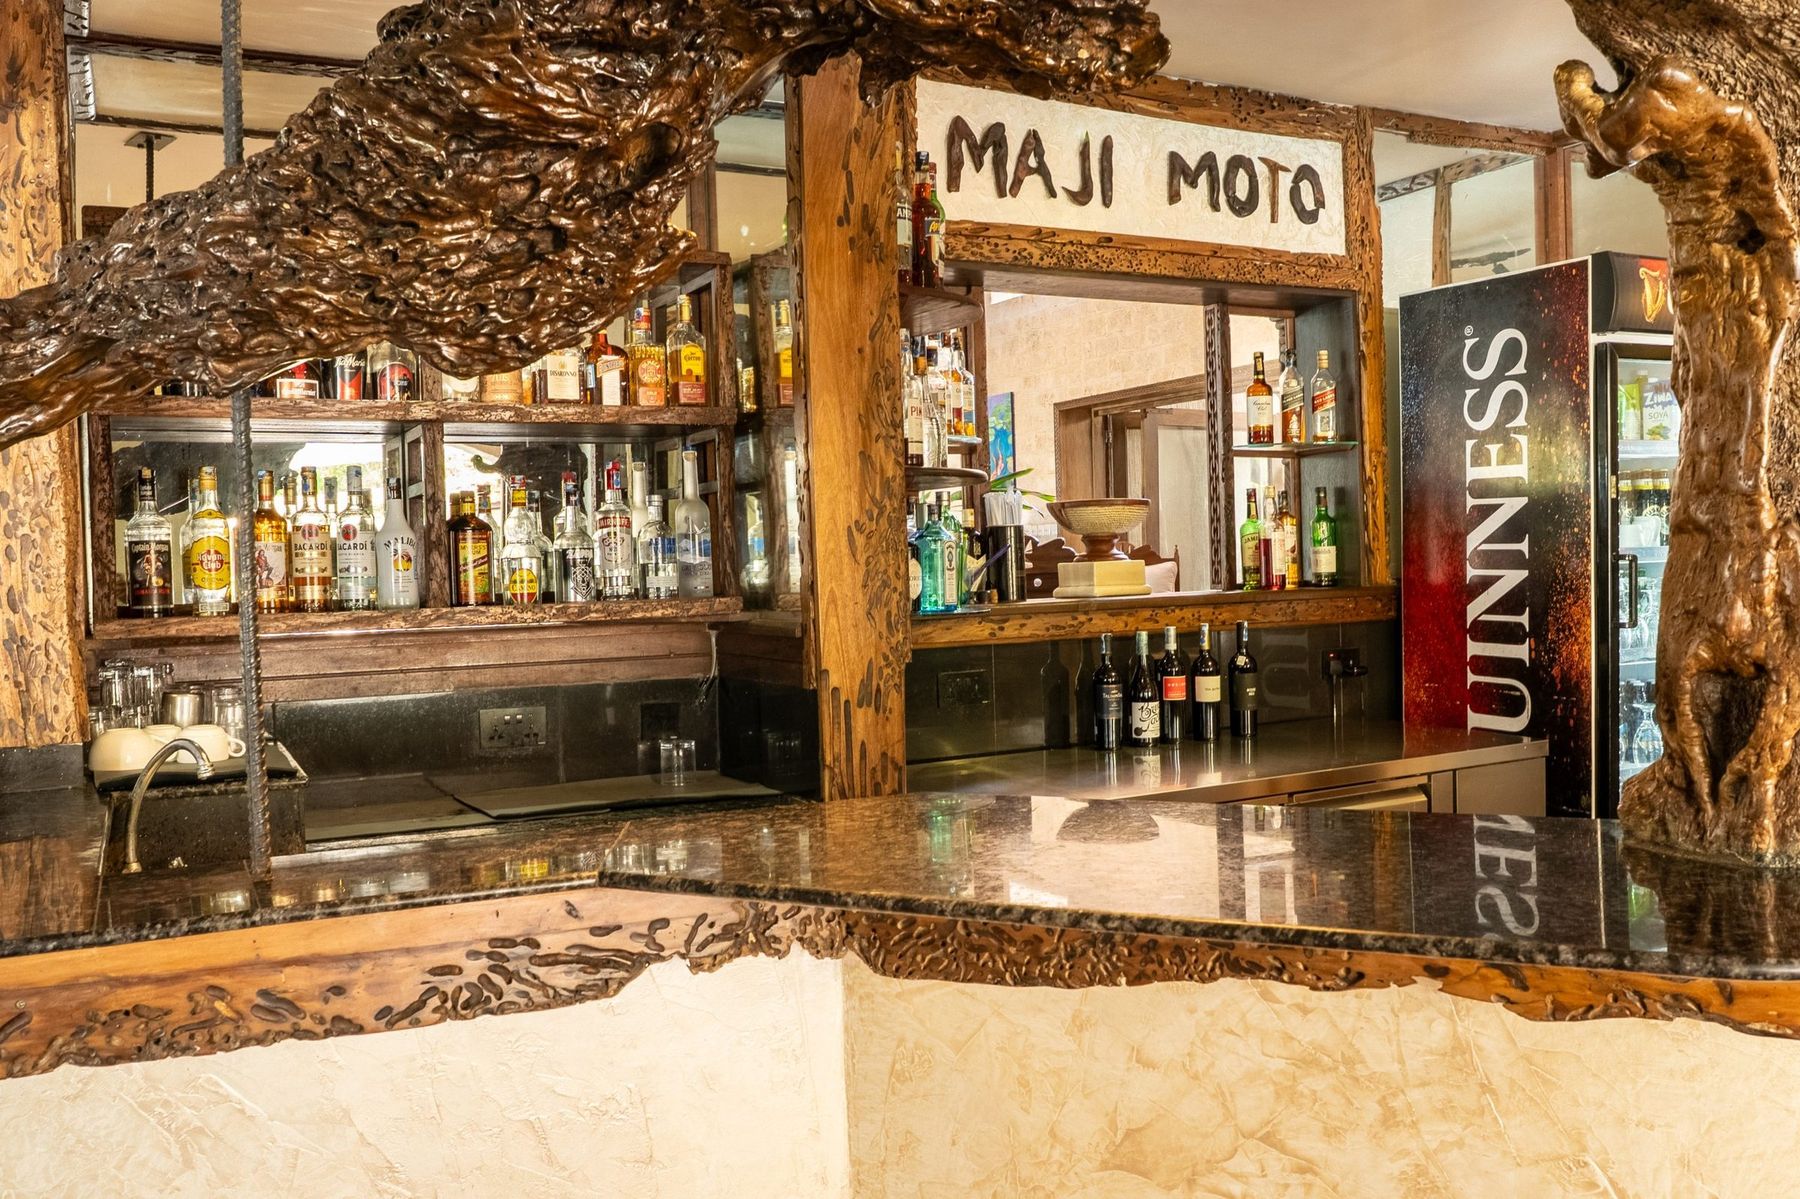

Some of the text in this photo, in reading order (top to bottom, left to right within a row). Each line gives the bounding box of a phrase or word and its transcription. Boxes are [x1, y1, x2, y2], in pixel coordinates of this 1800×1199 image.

[946, 115, 1326, 225] MAJI MOTO
[549, 369, 577, 377] DISARONNO
[1647, 411, 1669, 420] SOYA
